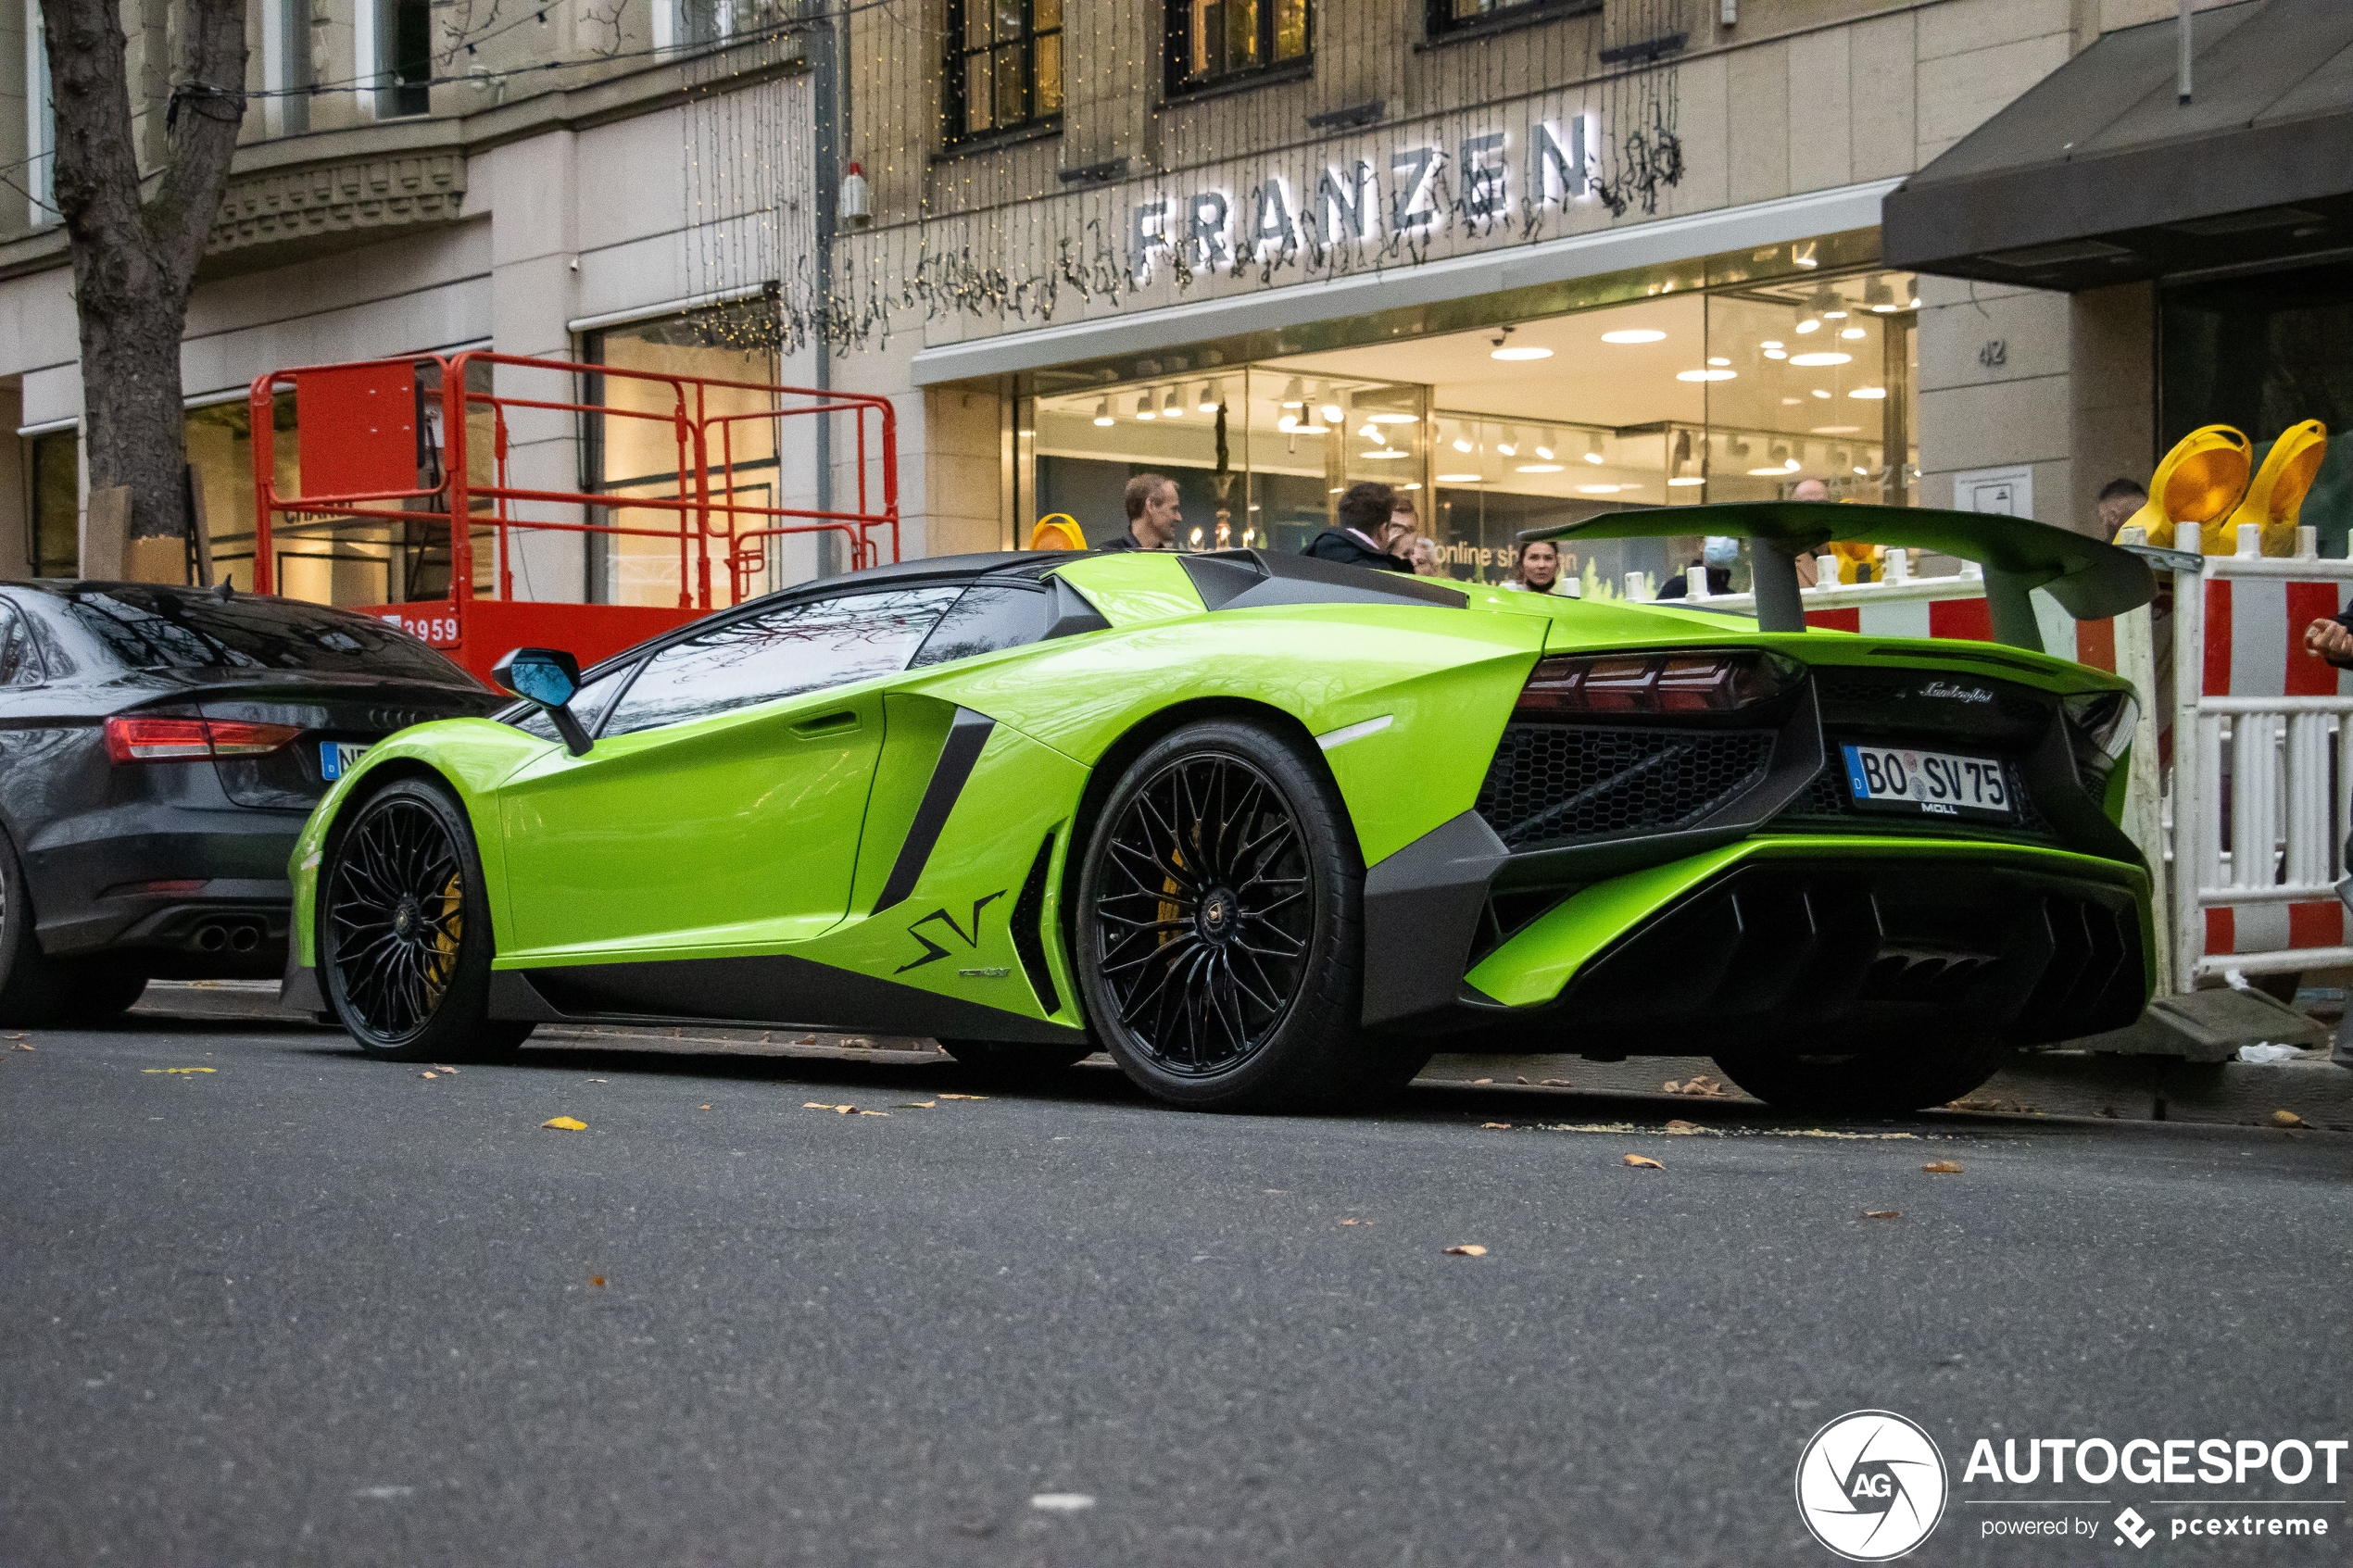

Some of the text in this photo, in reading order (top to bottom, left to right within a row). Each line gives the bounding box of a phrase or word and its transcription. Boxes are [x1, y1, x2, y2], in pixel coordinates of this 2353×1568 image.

[1131, 115, 1590, 278] FRANZEN
[1979, 339, 2007, 367] 42
[1435, 541, 1491, 567] online
[404, 618, 457, 641] 3959
[1919, 682, 1994, 703] Lamborghini
[1855, 778, 1862, 790] D
[1860, 752, 1907, 796] BO
[1921, 802, 1957, 815] MOLL
